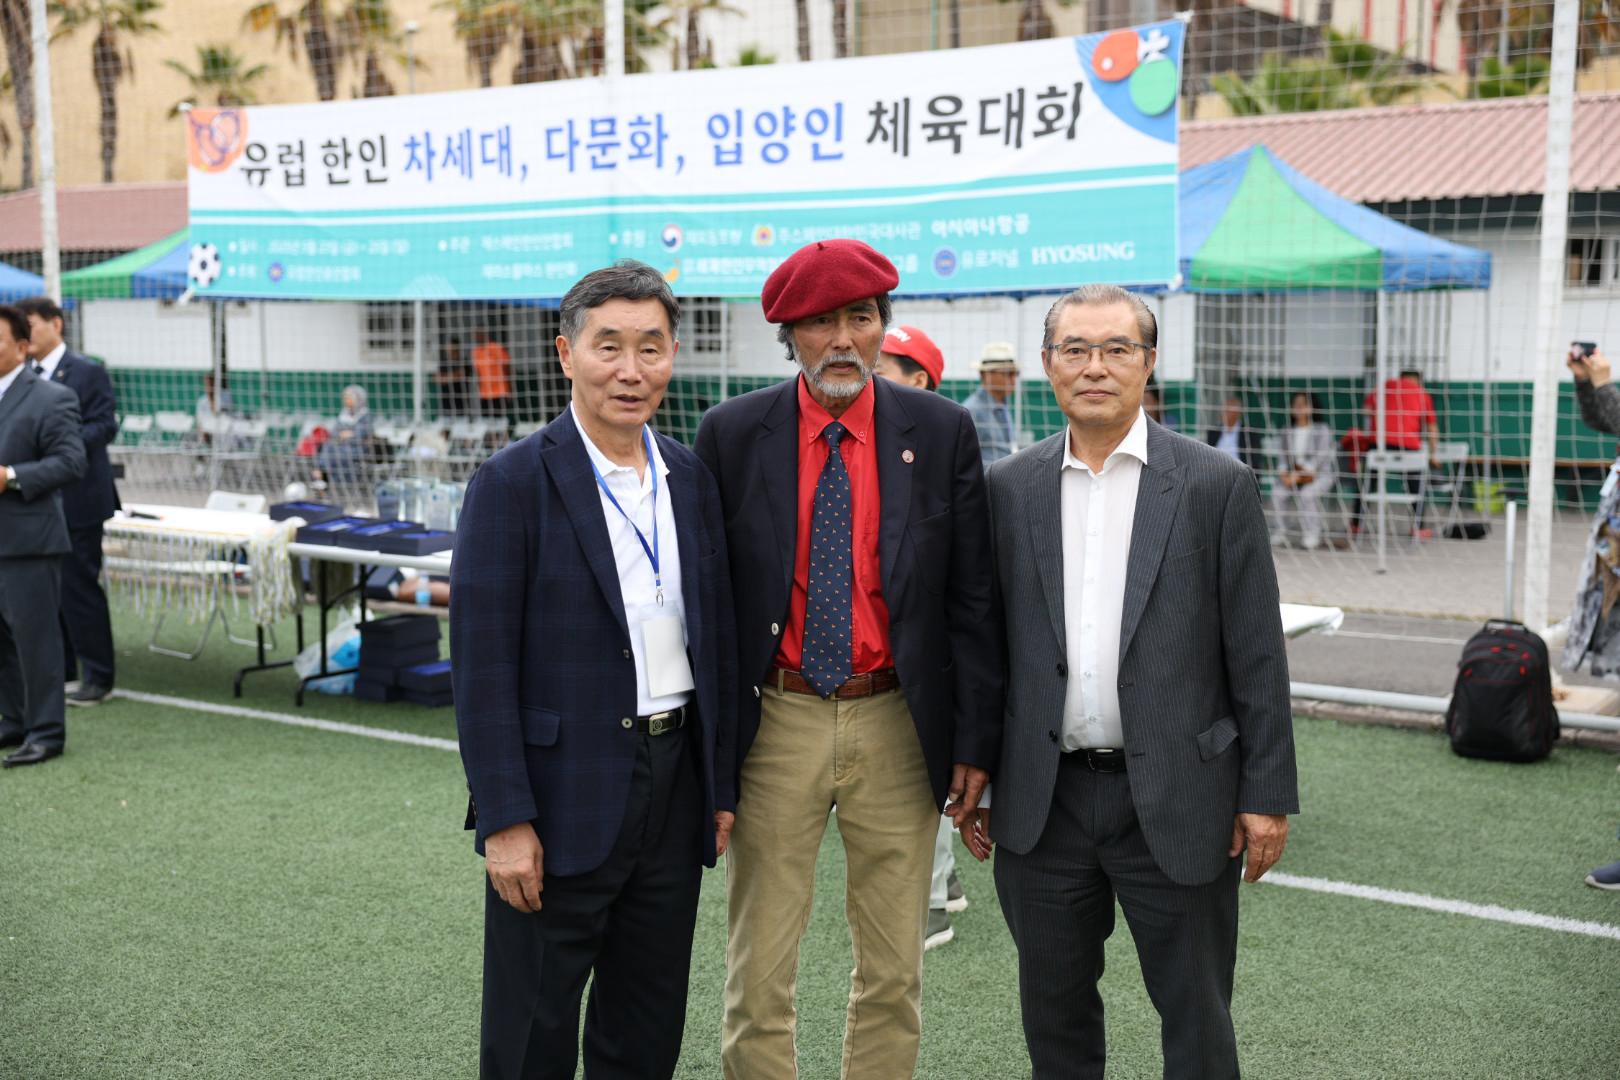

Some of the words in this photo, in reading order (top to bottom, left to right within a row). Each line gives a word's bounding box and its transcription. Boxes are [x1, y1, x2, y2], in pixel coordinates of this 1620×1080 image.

[241, 139, 305, 187] 유럽
[321, 134, 388, 185] 한인
[404, 125, 528, 182] 차세대,
[545, 112, 685, 174] 다문화,
[706, 101, 844, 166] 입양인
[866, 81, 1083, 157] 체육대회
[1031, 240, 1136, 265] HYOSUNG
